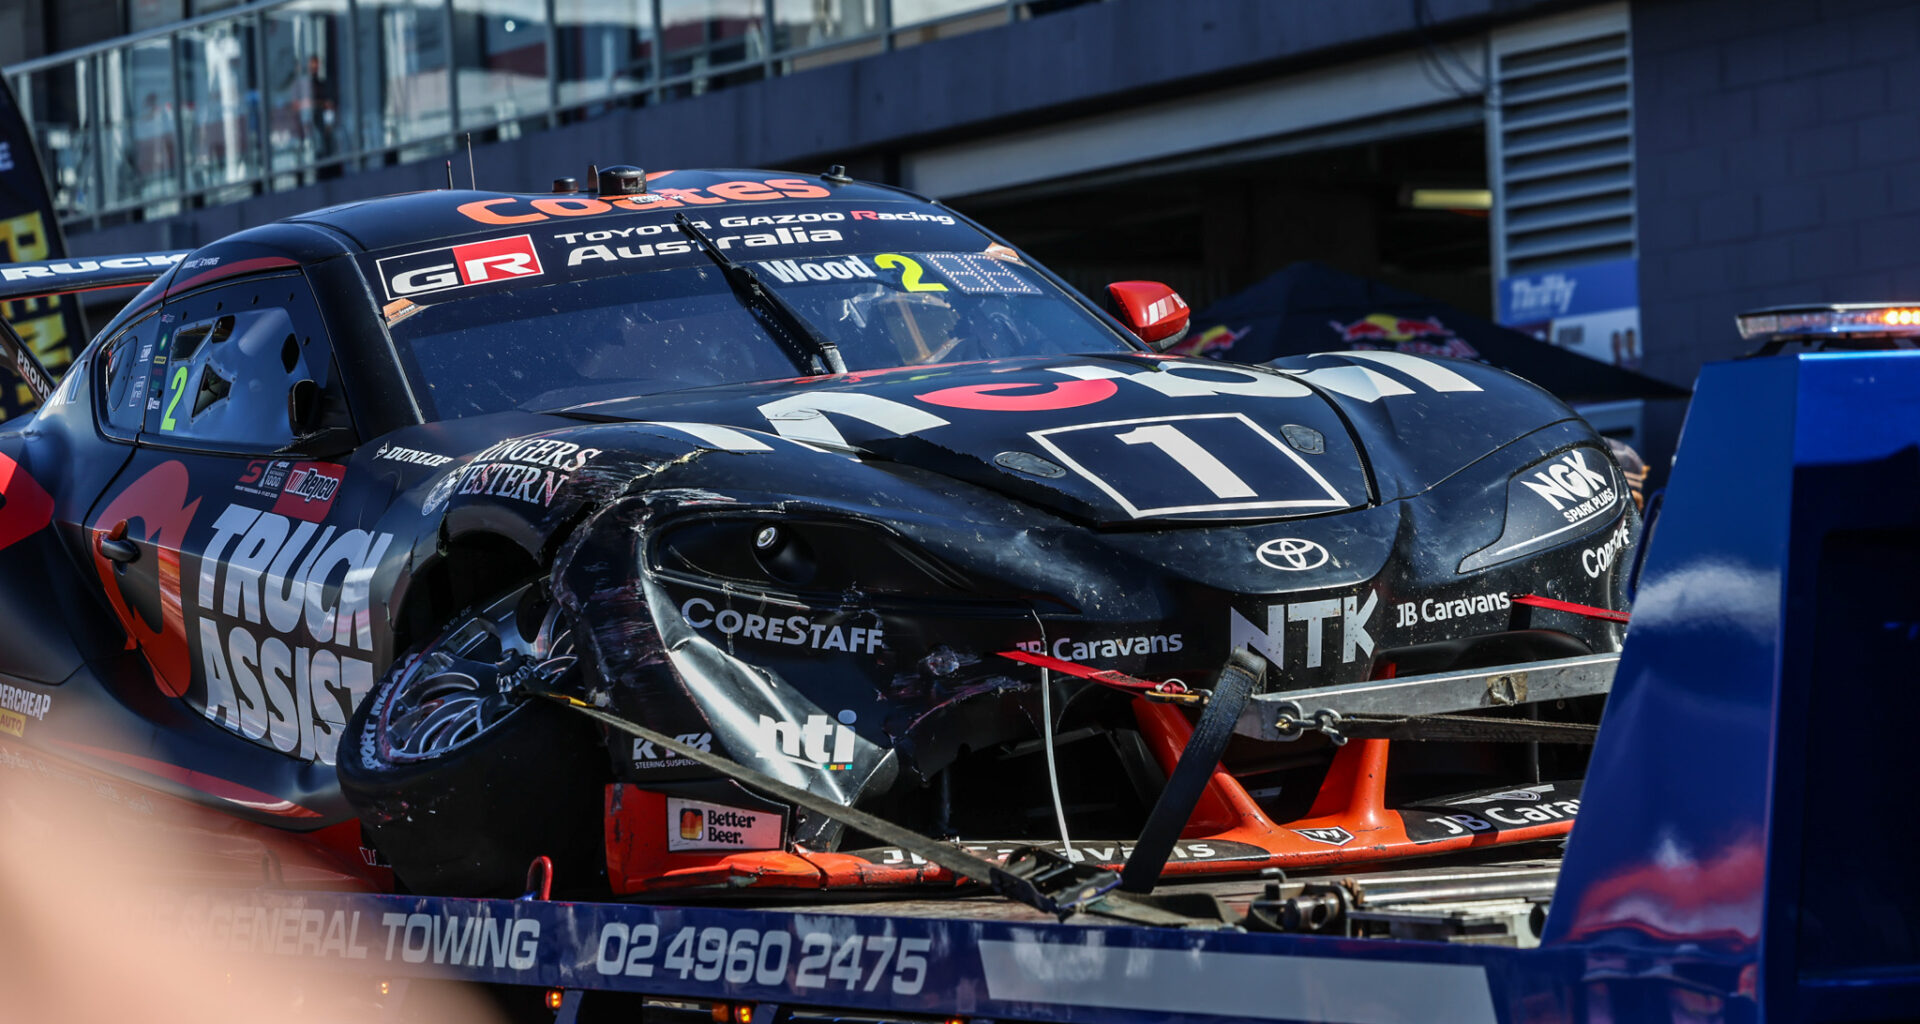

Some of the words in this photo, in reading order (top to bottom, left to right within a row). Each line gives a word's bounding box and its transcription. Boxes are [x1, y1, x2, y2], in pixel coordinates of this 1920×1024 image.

[457, 178, 831, 225] Coates
[554, 221, 712, 244] TOYOTA
[720, 211, 844, 227] GAZOO
[850, 210, 955, 225] Racing
[568, 226, 843, 266] Ausralia
[392, 252, 535, 294] GR
[758, 255, 877, 283] Wood
[874, 253, 949, 292] 2
[160, 366, 189, 431] 2
[383, 446, 454, 467] DUNLOP
[475, 438, 603, 472] INGERS
[1114, 424, 1258, 498] 1
[299, 468, 339, 502] Repco
[1520, 449, 1608, 511] NGK
[1563, 504, 1595, 523] SPARK
[1591, 487, 1615, 509] PLUGS
[198, 503, 394, 652] TRUCK
[1230, 588, 1378, 670] NTK
[1396, 602, 1418, 628] JB
[1421, 591, 1511, 622] Caravans
[1052, 632, 1183, 662] Caravans
[198, 616, 373, 766] ASSIST
[1, 713, 22, 730] AUTO
[756, 709, 857, 765] nti
[708, 810, 756, 828] Better
[708, 827, 744, 844] Beer.
[1427, 813, 1489, 835] JB
[1484, 798, 1580, 825] Cara
[209, 904, 366, 959] GENERAL
[381, 912, 540, 970] TOWING
[597, 922, 660, 978] 02
[664, 926, 791, 986] 4960
[795, 932, 931, 996] 2475
